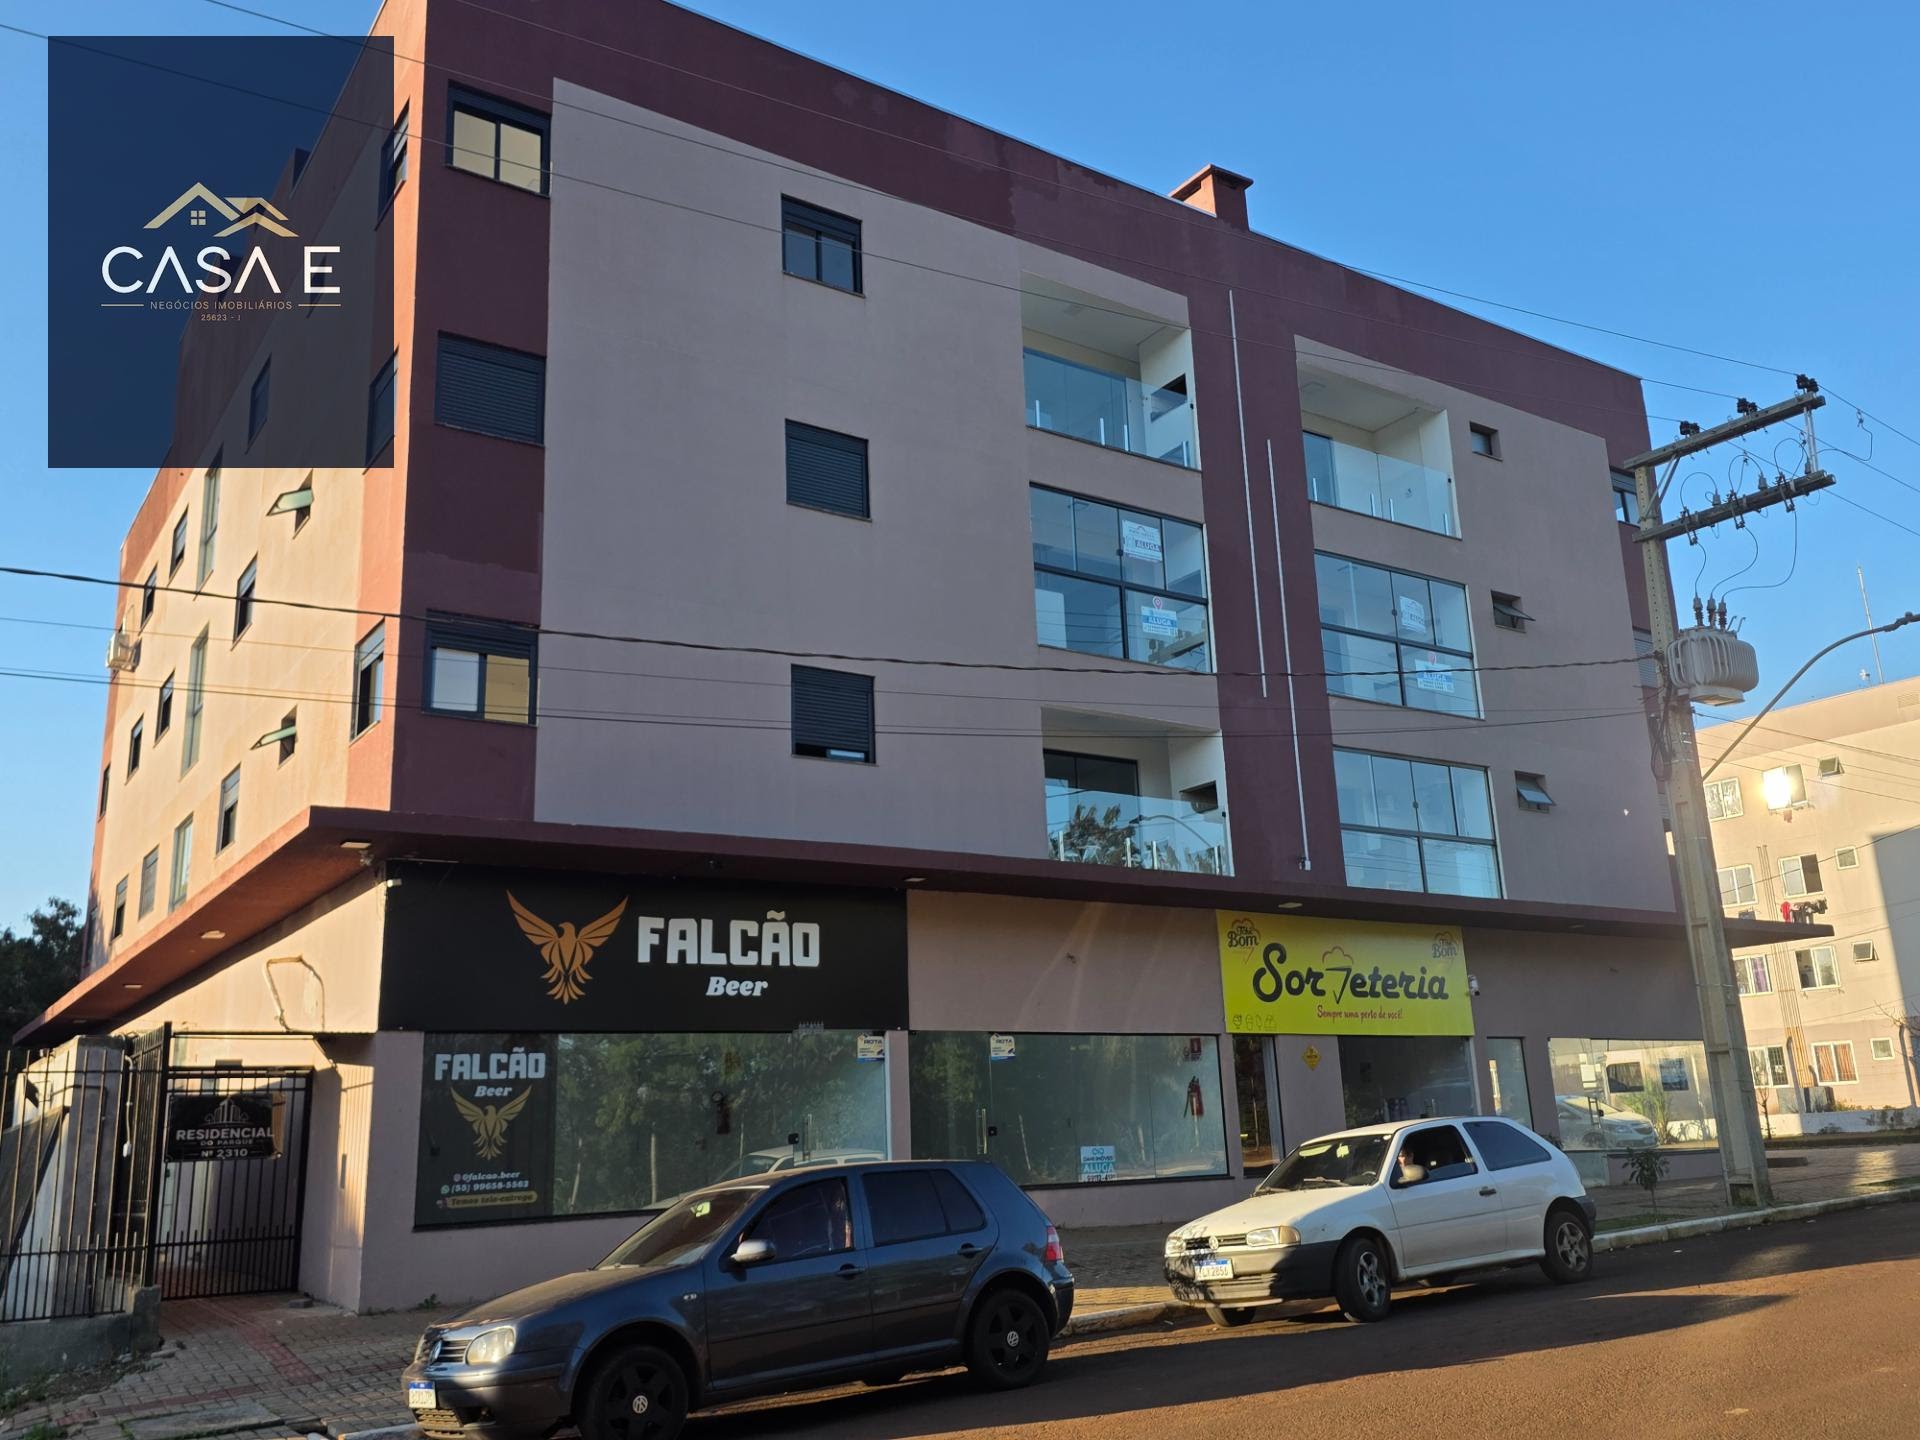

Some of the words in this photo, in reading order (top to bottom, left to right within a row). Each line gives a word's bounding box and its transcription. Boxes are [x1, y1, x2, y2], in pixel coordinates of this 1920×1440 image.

[1148, 616, 1172, 626] ALUGA
[637, 910, 820, 967] FALCÃO
[1227, 930, 1260, 948] Bom
[706, 976, 768, 997] Beer
[434, 1047, 546, 1080] FALCÃO
[474, 1085, 513, 1097] Beer
[176, 1127, 274, 1141] RESIDENCIAL
[216, 1148, 248, 1158] 2310
[1083, 1162, 1114, 1173] ALUGA
